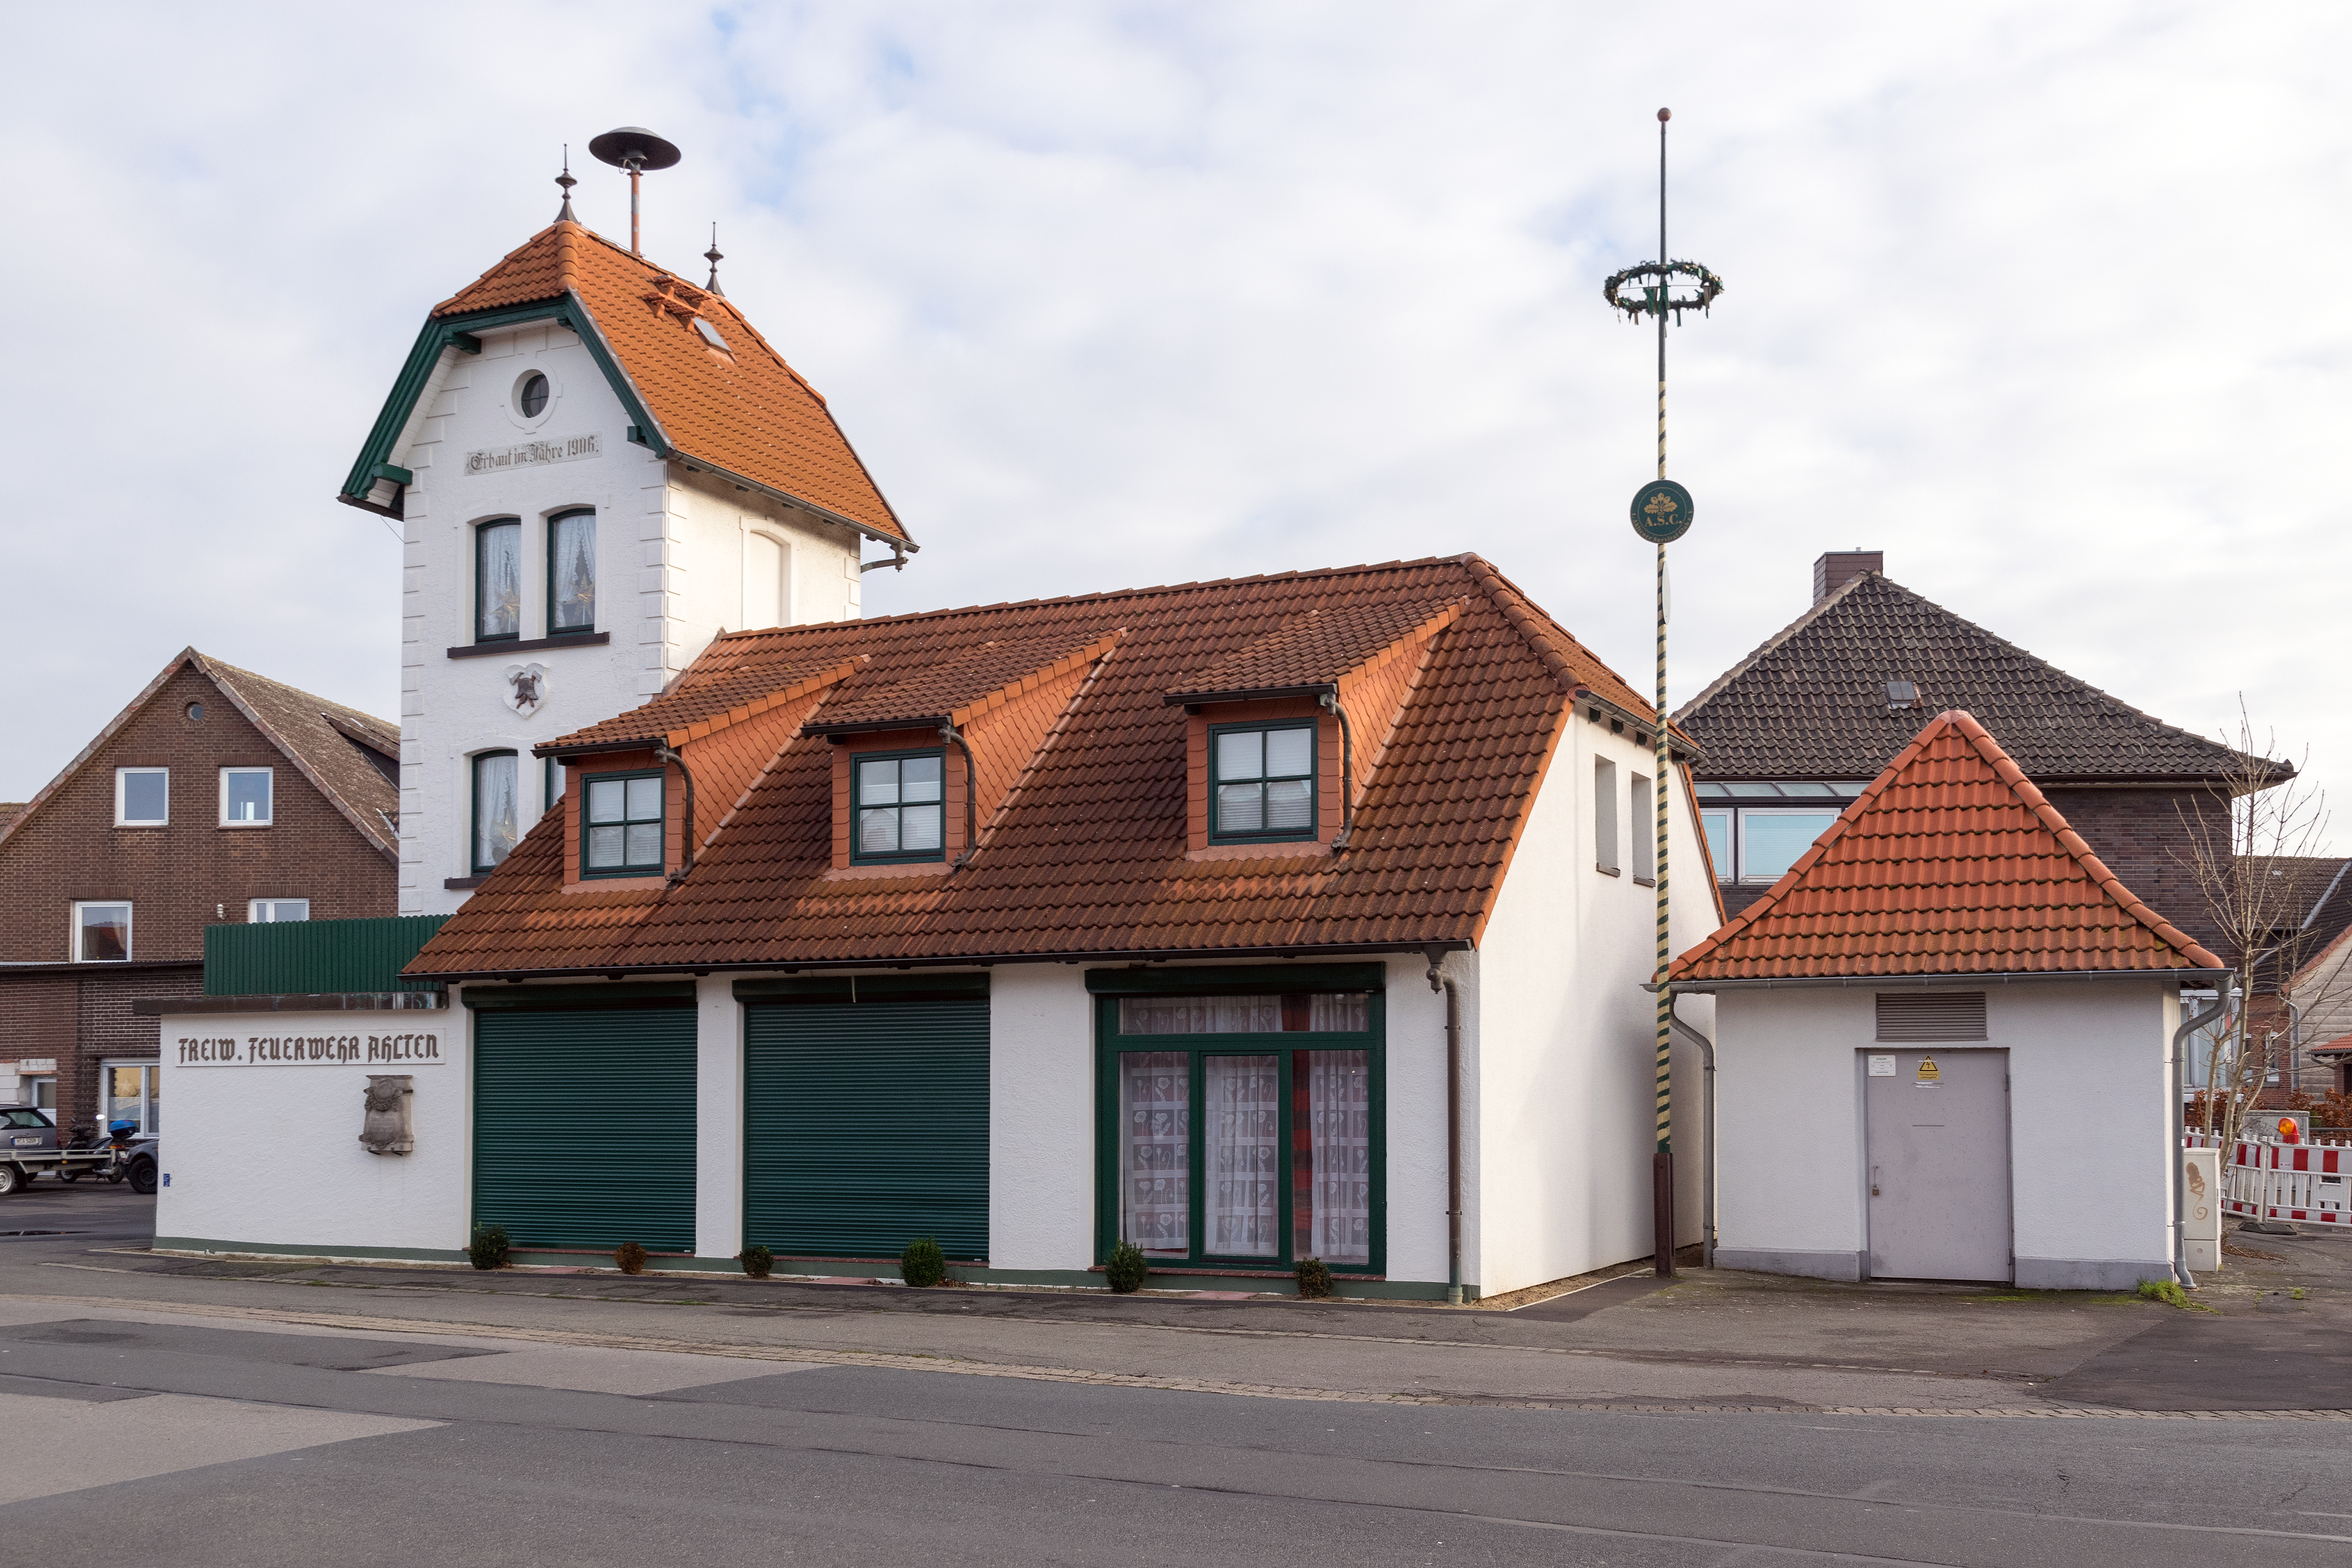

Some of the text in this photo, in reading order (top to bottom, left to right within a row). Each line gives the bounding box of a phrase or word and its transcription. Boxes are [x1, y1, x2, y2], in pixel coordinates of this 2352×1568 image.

[469, 449, 513, 470] Erbaut
[514, 448, 528, 465] im
[526, 441, 563, 464] Jahre
[1644, 514, 1682, 527] A.S.C.
[1653, 532, 1679, 542] Survival
[1678, 522, 1690, 535] Club
